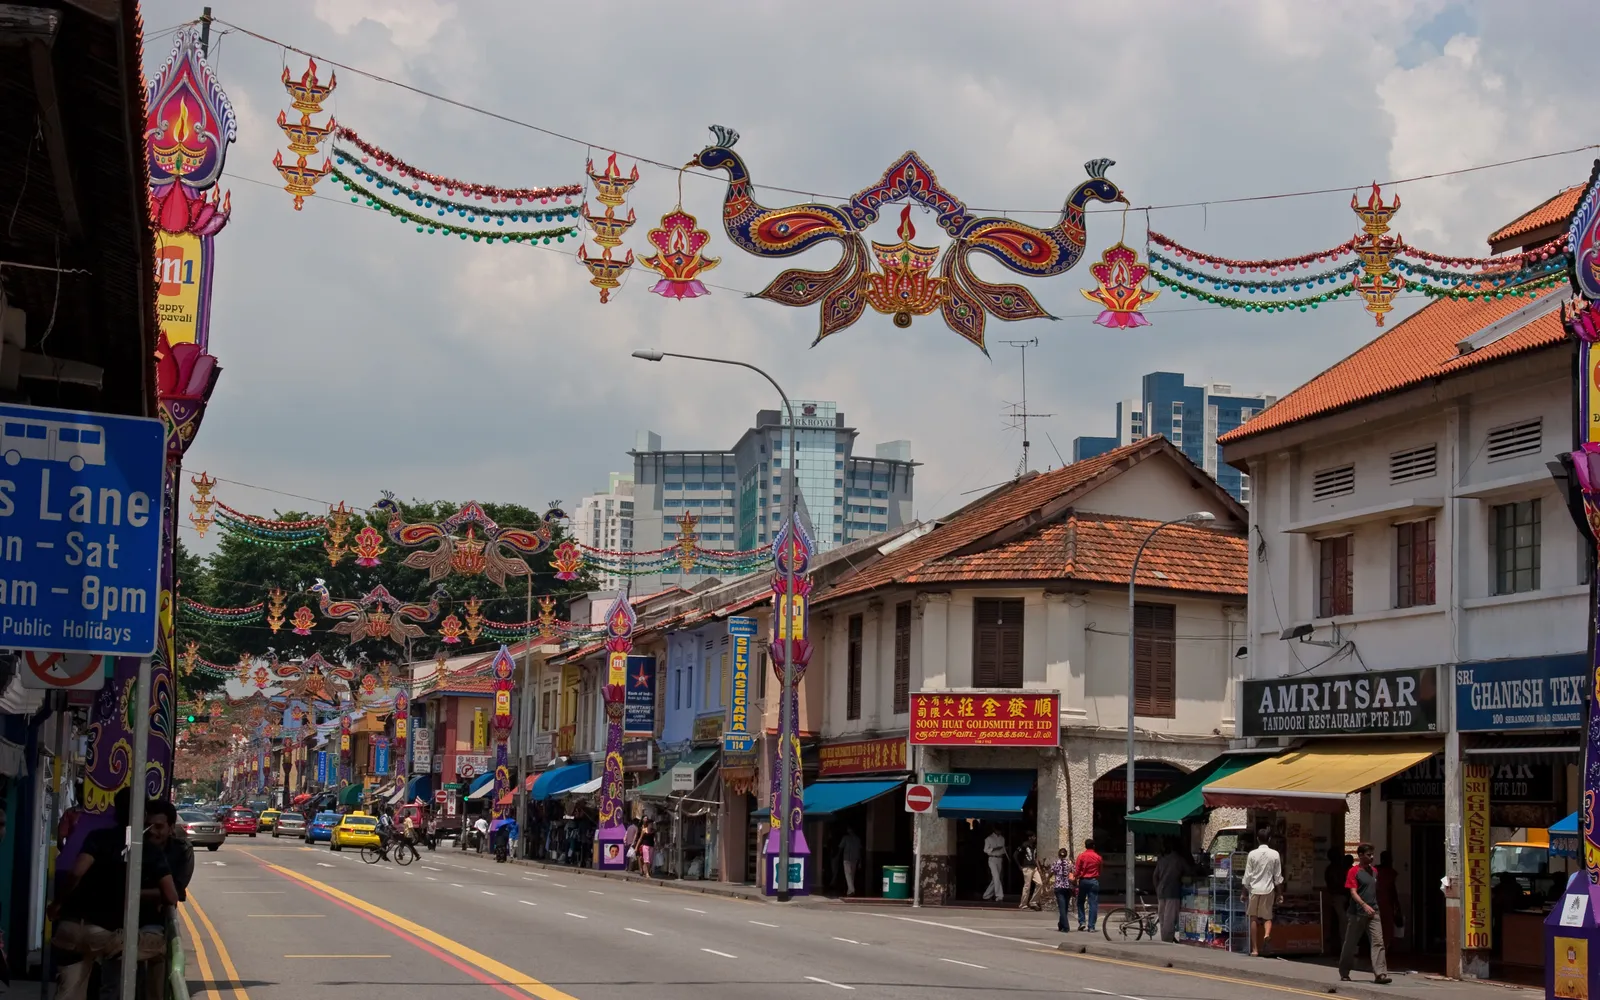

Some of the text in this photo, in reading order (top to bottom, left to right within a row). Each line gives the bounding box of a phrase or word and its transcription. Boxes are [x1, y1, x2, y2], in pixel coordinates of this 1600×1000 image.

[158, 303, 185, 313] appy
[161, 313, 192, 323] pavali
[784, 418, 836, 427] PRKROYAL
[40, 468, 150, 528] Lane
[65, 531, 120, 569] Sat
[81, 575, 147, 621] 8pm
[2, 616, 132, 646] Public Holidays
[732, 637, 748, 731] SELVASEGARA
[1456, 669, 1474, 685] SRI
[1258, 676, 1418, 714] AMRITSAR
[1471, 678, 1544, 711] GHANESH
[916, 720, 1052, 729] SOON HUAT GOLDSMITH PTE LTD
[1262, 710, 1412, 731] TANDOORI RESTAURANT PTE LTD
[1492, 712, 1580, 724] 100 SERANGOON ROAD SINGAPORE
[732, 741, 745, 750] 114
[927, 774, 966, 783] Cuff Rd
[1465, 764, 1487, 778] 100
[1465, 782, 1486, 792] SRI
[1494, 782, 1509, 796] PTE
[1511, 782, 1528, 796] LTD
[1467, 795, 1486, 929] GHANESH TEXTILES
[1467, 932, 1488, 947] 100
